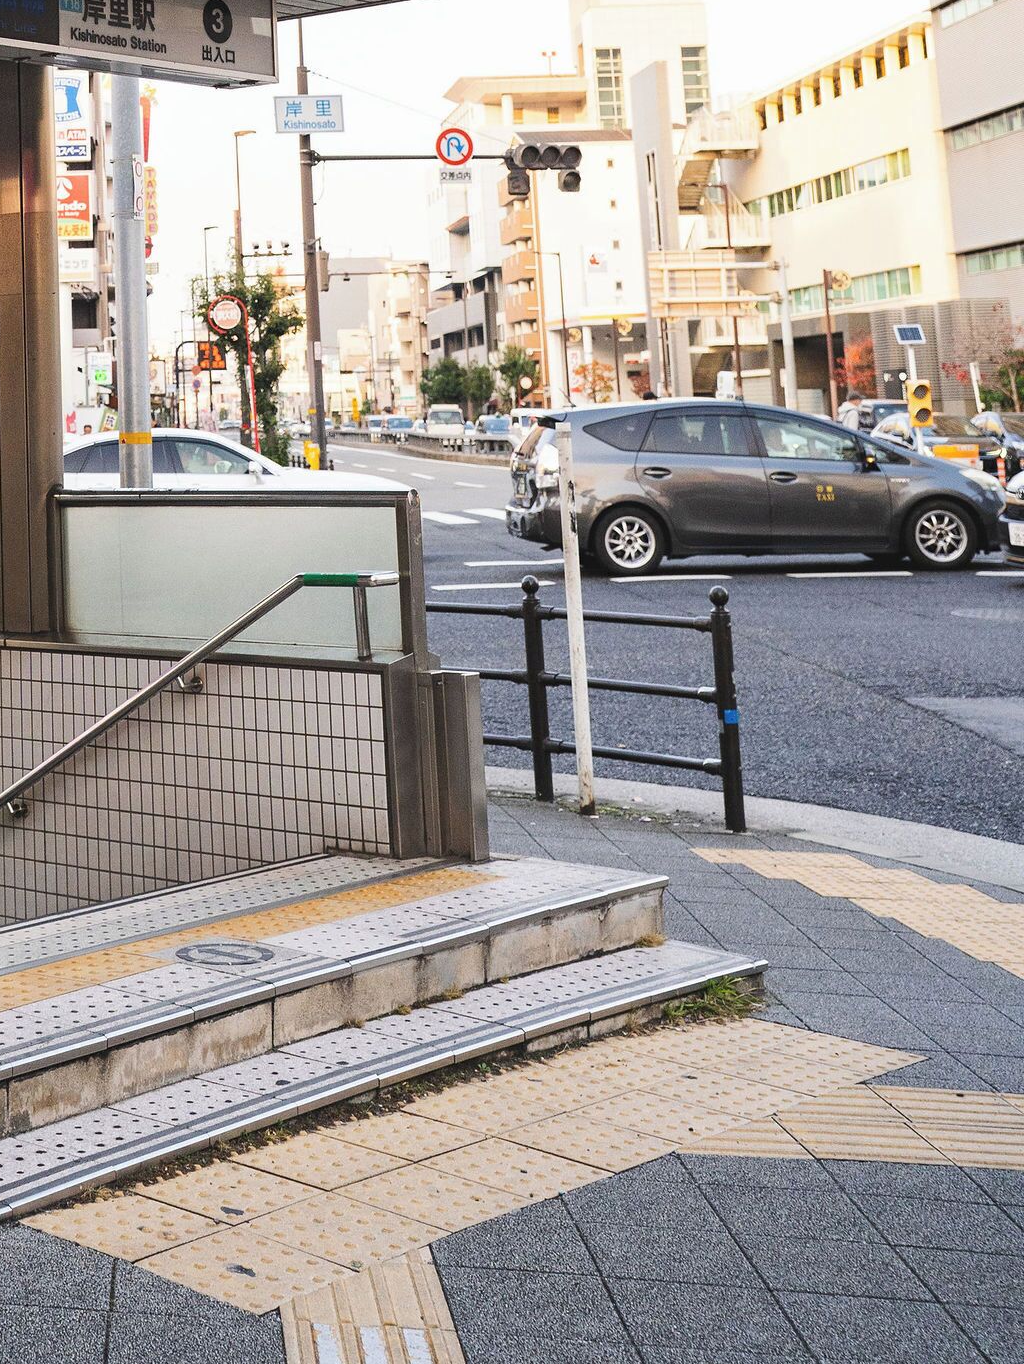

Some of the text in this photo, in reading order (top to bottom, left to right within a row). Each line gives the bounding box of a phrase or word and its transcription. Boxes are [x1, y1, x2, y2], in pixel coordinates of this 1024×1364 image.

[211, 8, 225, 34] 3
[70, 27, 167, 54] Kishinosato Station
[202, 45, 236, 64] 出入口
[283, 119, 337, 130] Kishinosato
